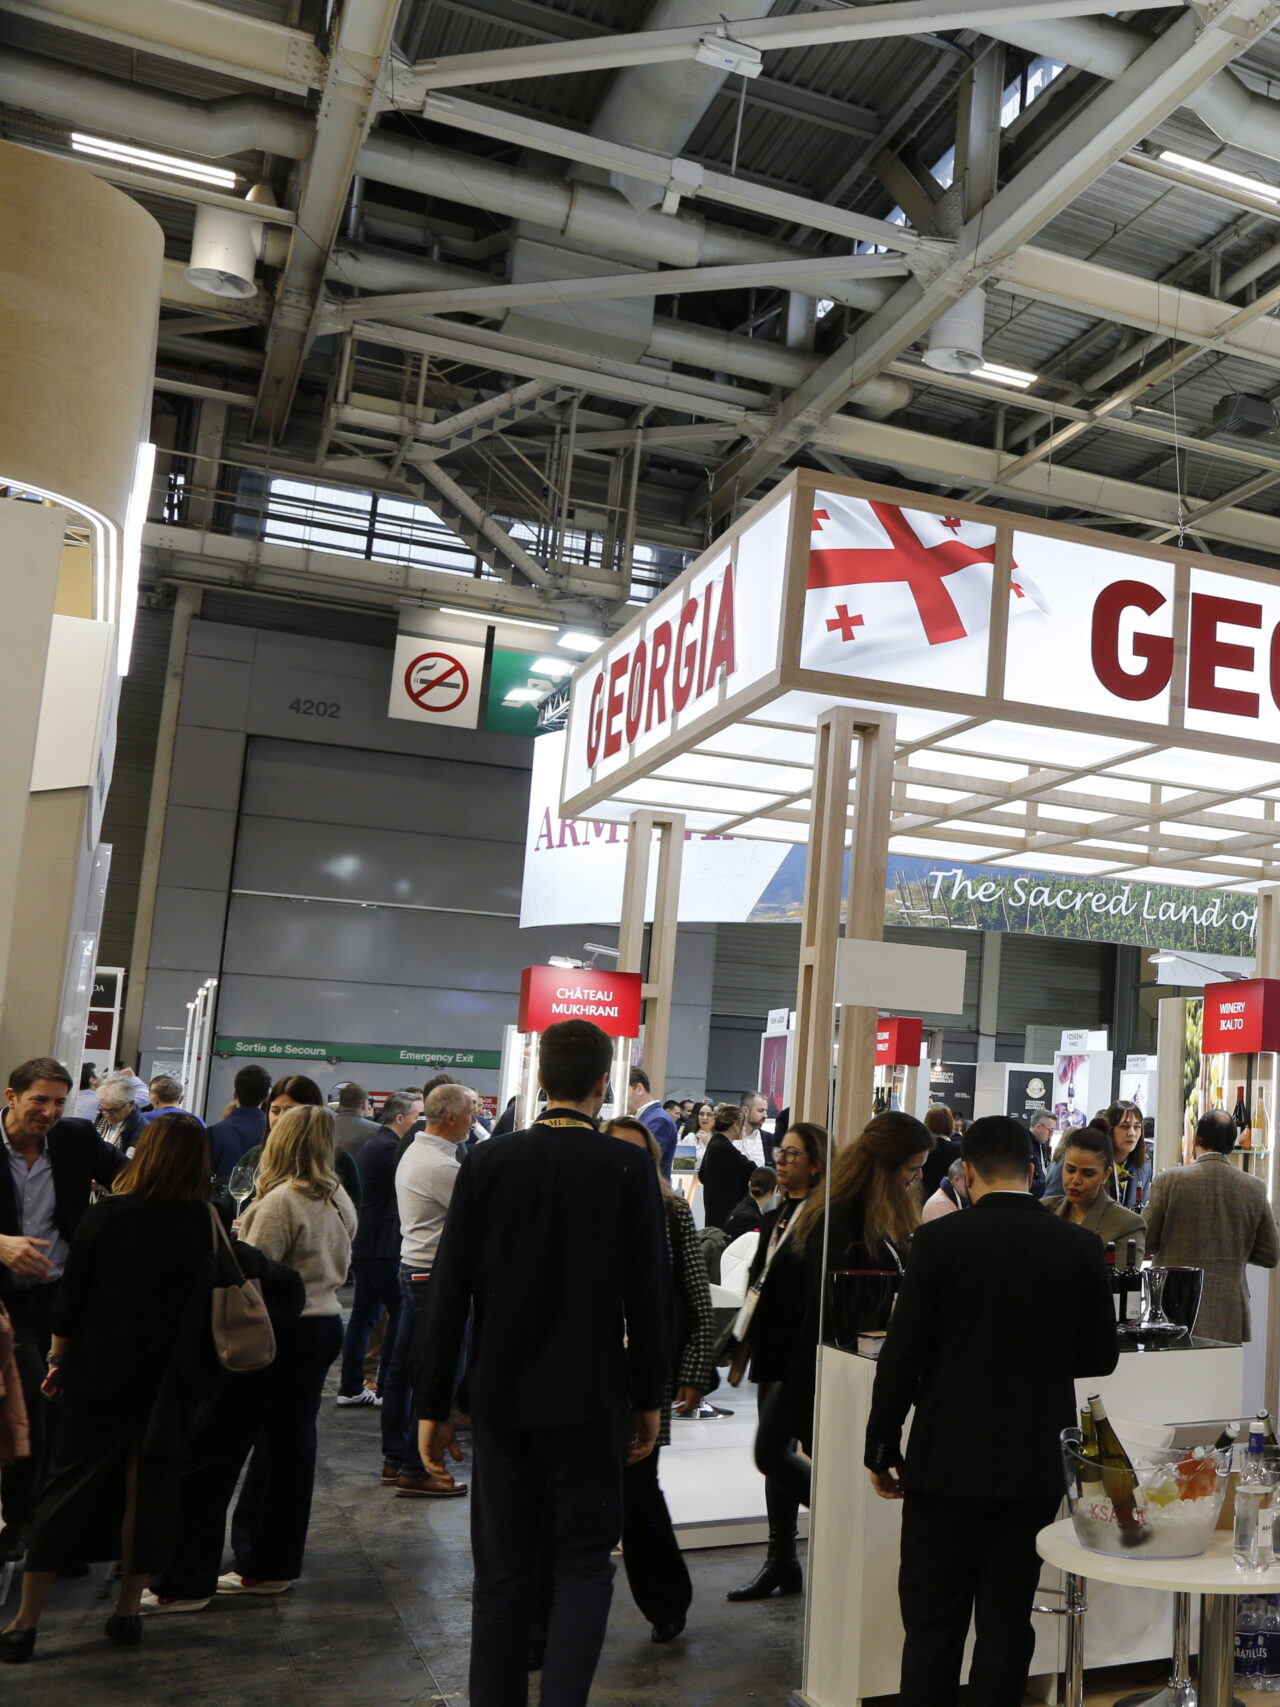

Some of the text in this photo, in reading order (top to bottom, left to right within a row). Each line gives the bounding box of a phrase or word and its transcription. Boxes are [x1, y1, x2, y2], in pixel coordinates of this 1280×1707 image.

[586, 563, 738, 770] GEORGIA
[289, 698, 341, 719] 4202
[928, 868, 1004, 903] The
[1008, 876, 1138, 918] Sacred
[1143, 890, 1228, 929] Land
[556, 986, 614, 1002] CHÂTEAU
[551, 1003, 619, 1017] MUKHRANI
[1219, 1001, 1246, 1014] WINERY
[1219, 1018, 1244, 1031] IKALTO
[235, 1041, 327, 1056] Sortie de Secours
[399, 1051, 475, 1063] Emergency Exit
[1234, 1647, 1267, 1659] BATILLES
